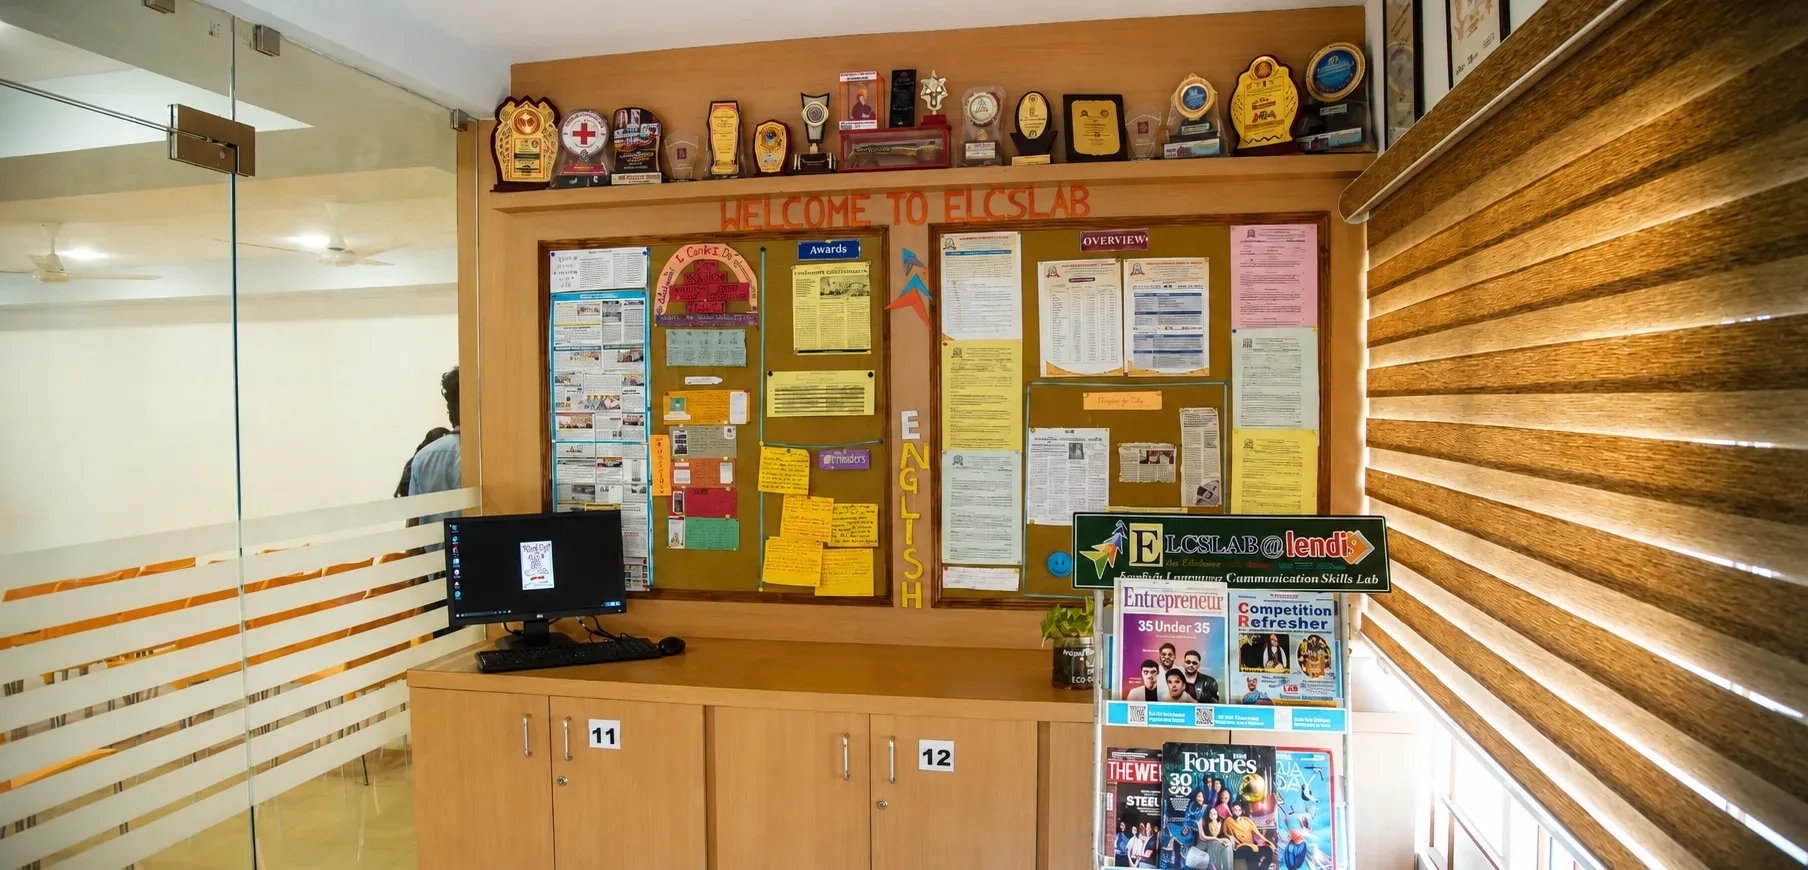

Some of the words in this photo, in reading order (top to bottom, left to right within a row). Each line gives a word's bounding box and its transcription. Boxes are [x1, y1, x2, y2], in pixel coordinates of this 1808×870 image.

[720, 193, 871, 232] WELCOME
[886, 191, 928, 227] TO
[944, 186, 1091, 224] ELCSLAB
[1083, 235, 1146, 246] OVERVIEW
[810, 244, 847, 255] Awards
[899, 411, 930, 609] ENGLISH
[1321, 573, 1354, 585] Skills
[1356, 574, 1379, 585] Lab
[1123, 586, 1224, 612] Entrepreneur
[1238, 602, 1332, 617] Competition
[1138, 620, 1153, 632] 35
[1155, 620, 1192, 633] Under
[1194, 622, 1210, 634] 35
[1238, 615, 1329, 630] Refresher
[592, 727, 616, 745] 11
[922, 748, 951, 767] 12
[1182, 751, 1257, 774] Forbes
[1169, 773, 1192, 786] 30
[1126, 795, 1160, 807] STEEL
